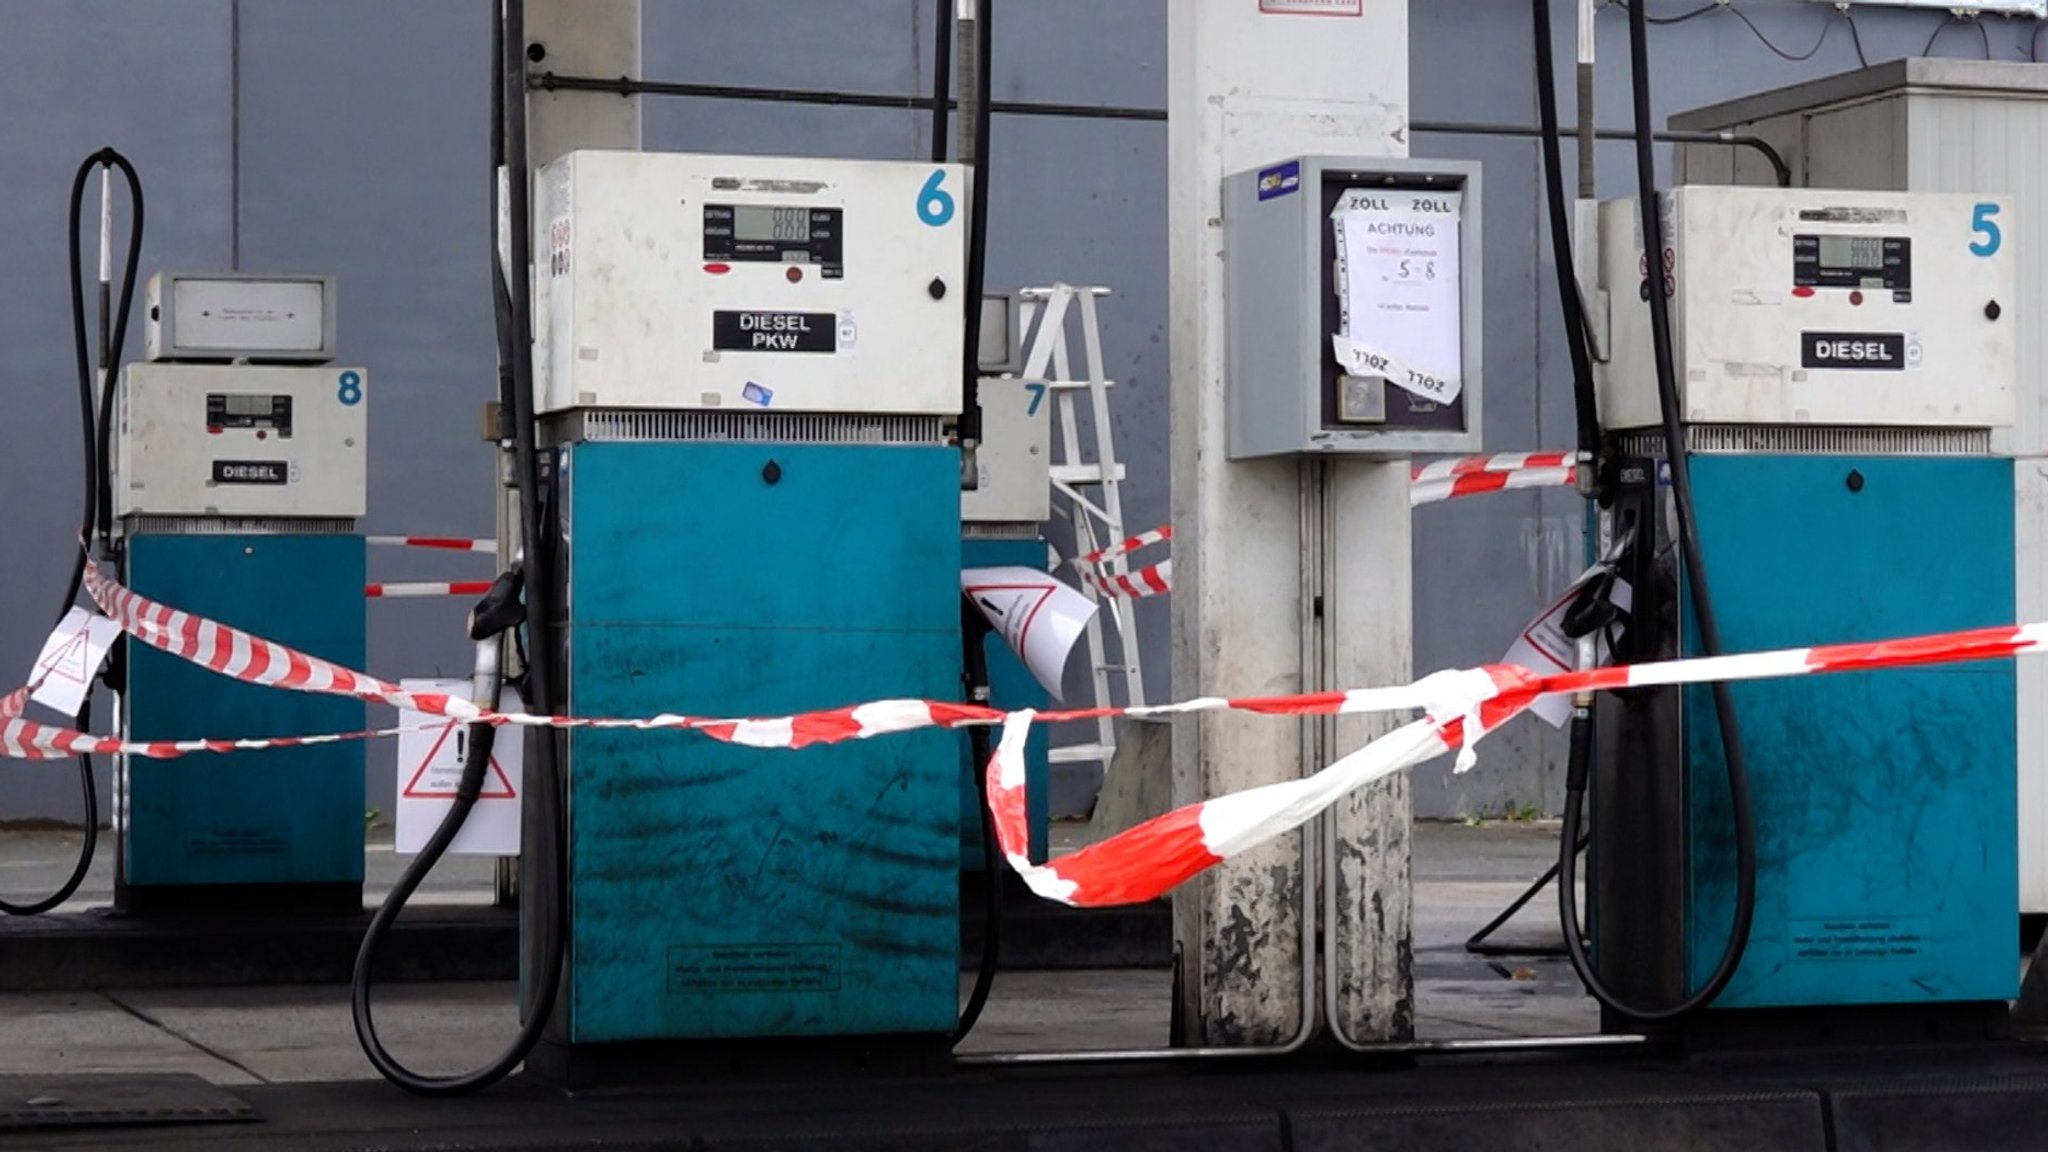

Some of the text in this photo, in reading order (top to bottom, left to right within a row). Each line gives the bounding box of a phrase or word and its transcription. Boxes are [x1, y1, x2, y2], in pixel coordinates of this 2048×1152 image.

[916, 168, 955, 227] 6
[1350, 197, 1451, 213] ZOLL ZOLL
[1368, 223, 1435, 237] ACHTUNG
[1969, 203, 2002, 257] 5
[740, 313, 811, 331] DIESEL
[753, 333, 798, 348] PKW
[1816, 341, 1893, 360] DIESEL
[1353, 349, 1447, 393] ZOLL ZOLL
[338, 370, 362, 406] 8
[1025, 384, 1046, 416] 7
[223, 465, 278, 480] DIESEL
